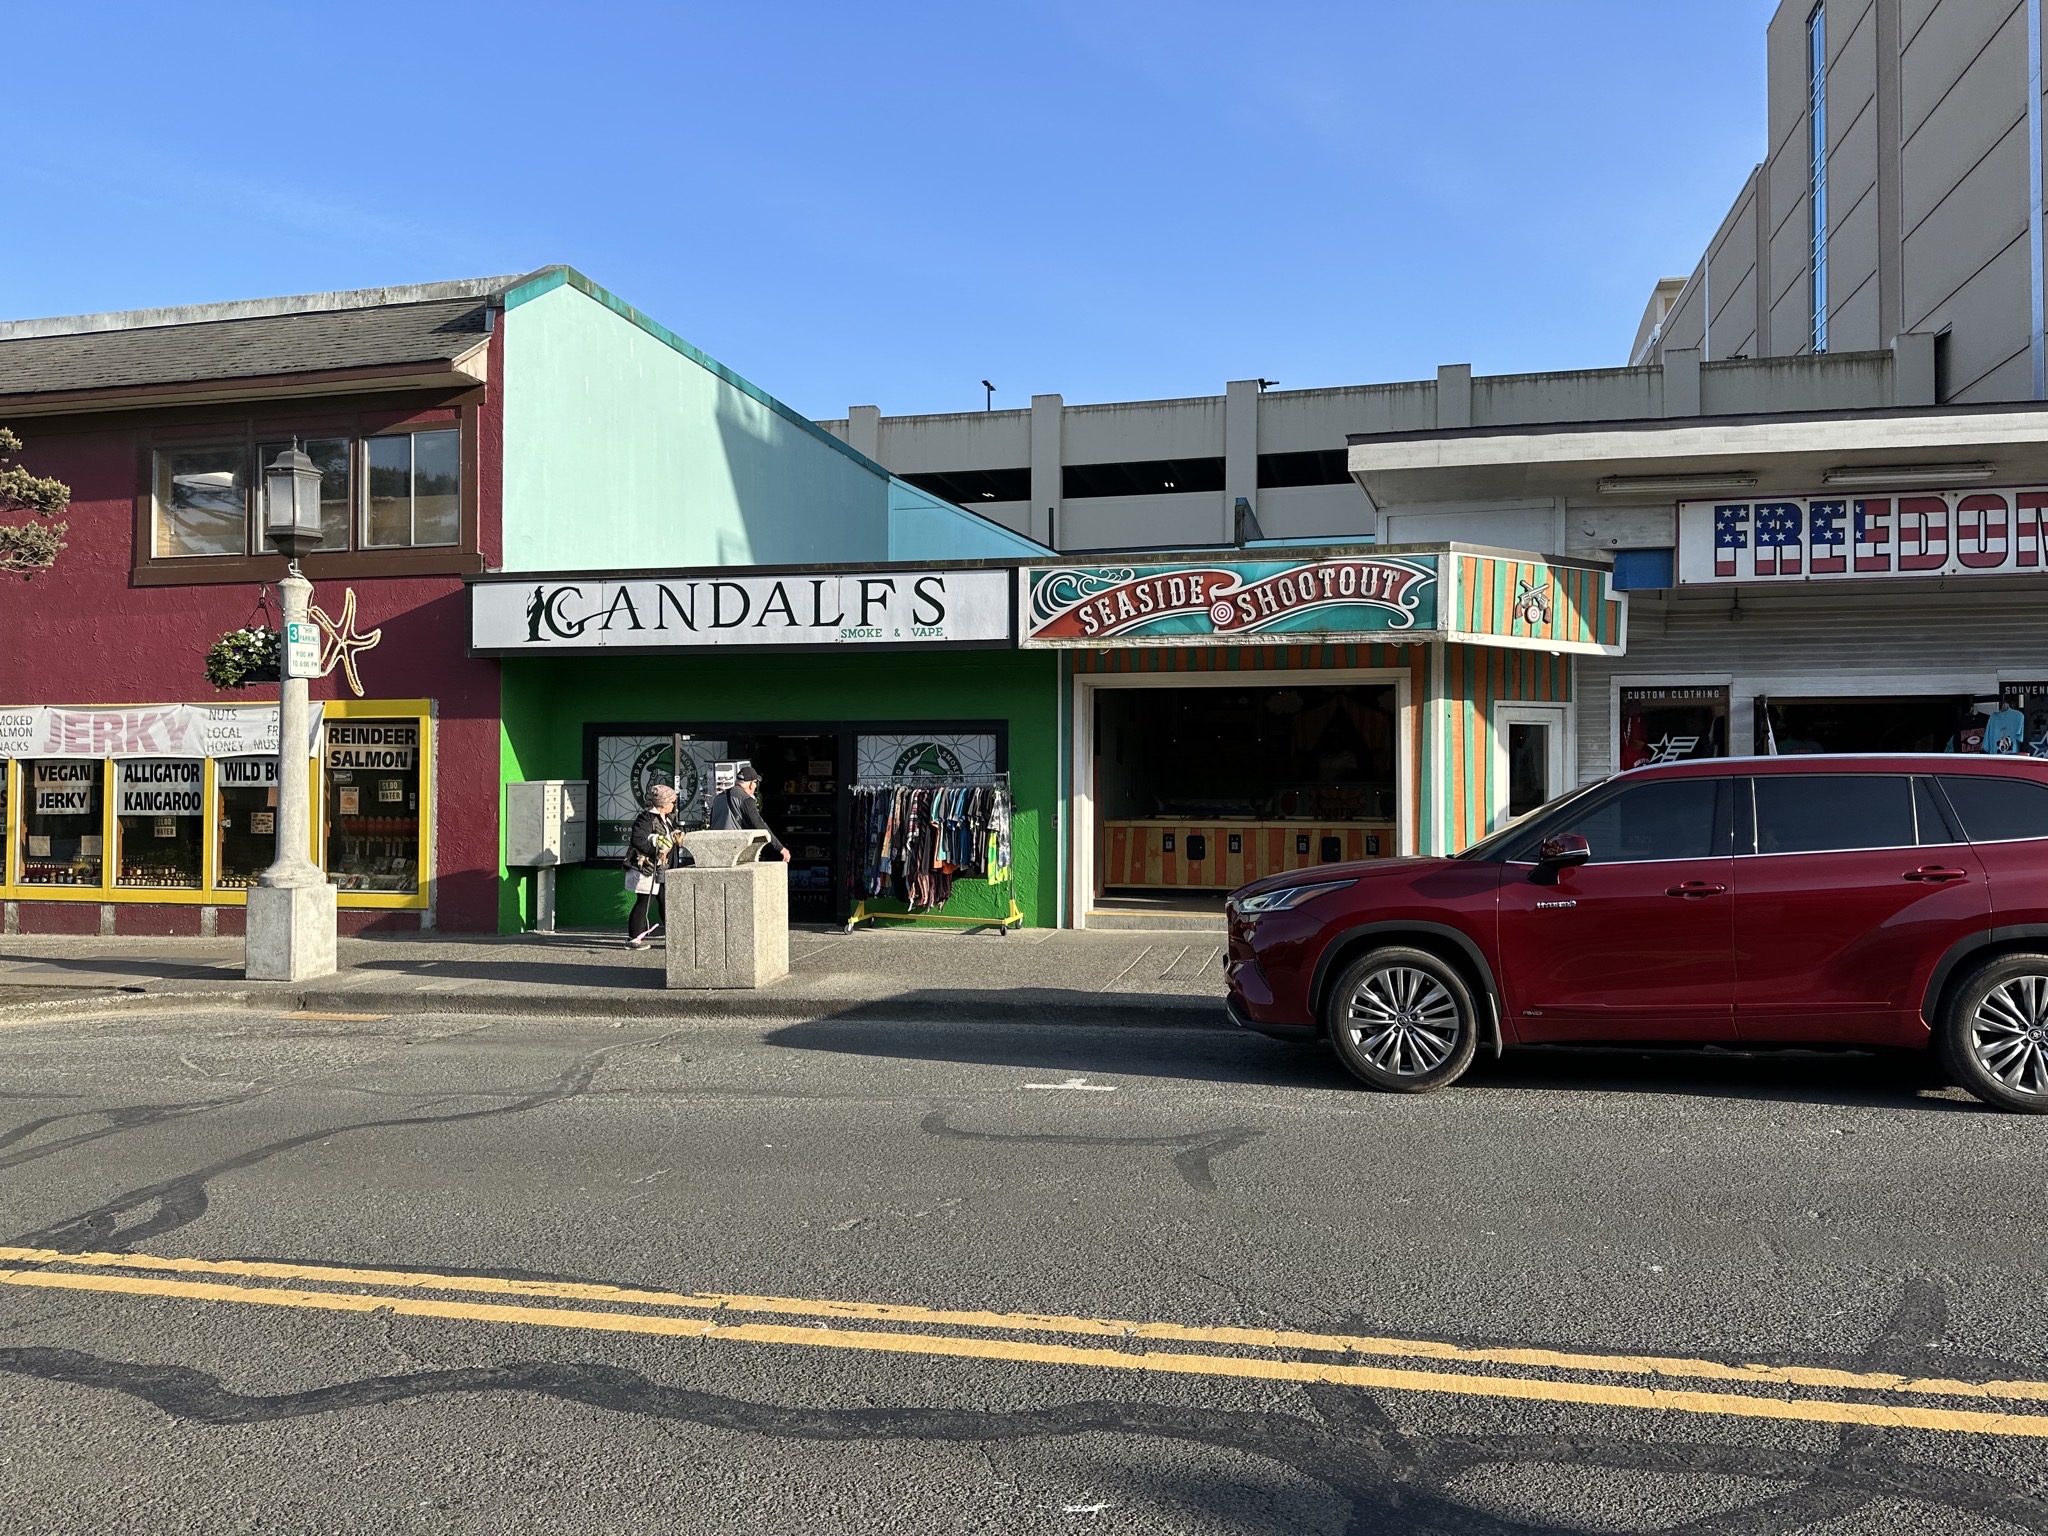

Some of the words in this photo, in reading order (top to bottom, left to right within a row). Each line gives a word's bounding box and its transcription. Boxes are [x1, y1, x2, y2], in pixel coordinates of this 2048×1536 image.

[544, 576, 946, 639] GANDALFS
[1078, 575, 1205, 635] SEASIDE
[1236, 565, 1401, 625] SHOOTOUT
[290, 626, 298, 641] 3
[840, 628, 883, 639] SMOKE
[893, 628, 901, 638] &
[911, 627, 944, 637] VAPE
[1627, 690, 1666, 699] CUSTOM
[1671, 689, 1720, 699] CLOTHING
[208, 708, 238, 721] NUTS
[43, 712, 193, 754] JERKY
[207, 726, 242, 739] LOCAL
[328, 727, 417, 745] REINDEER
[206, 739, 245, 752] HONEY
[330, 750, 408, 768] SALMON
[37, 764, 91, 782] VEGAN
[123, 763, 200, 783] ALLIGATOR
[224, 762, 260, 782] WILD
[38, 792, 87, 809] JERKY
[124, 791, 202, 811] KANGAROO
[380, 791, 401, 800] WATER
[156, 827, 174, 836] WATER
